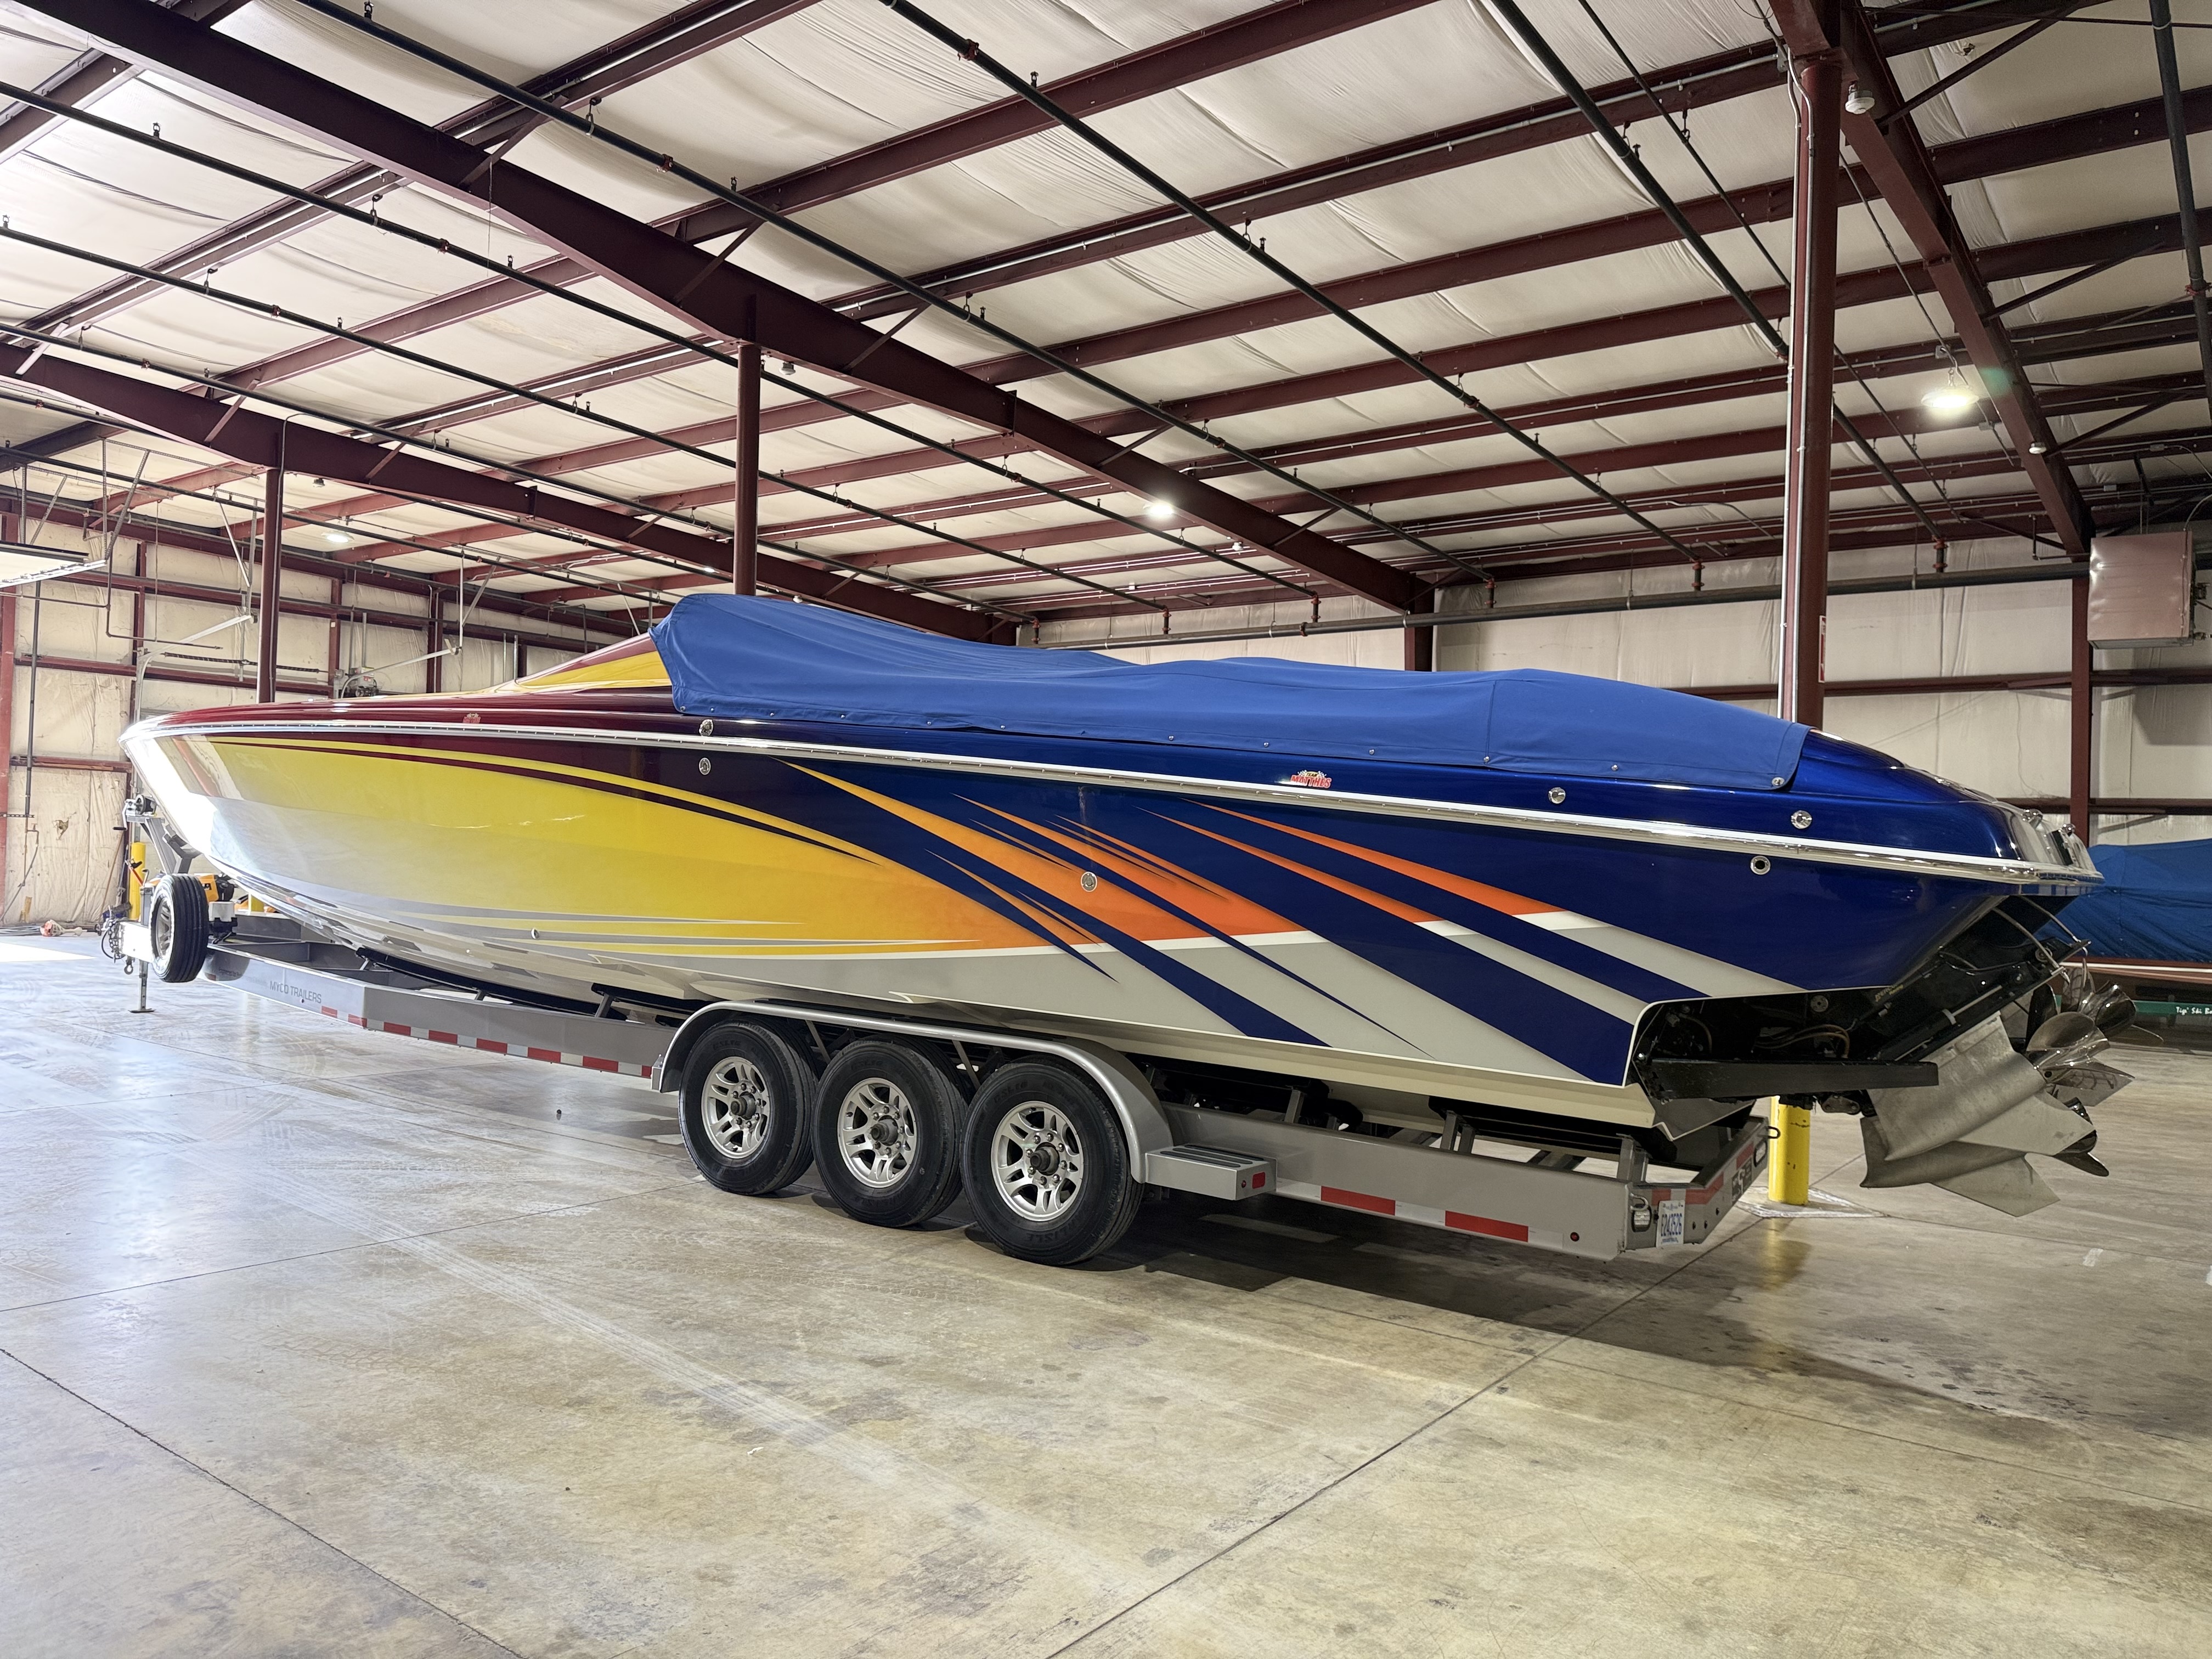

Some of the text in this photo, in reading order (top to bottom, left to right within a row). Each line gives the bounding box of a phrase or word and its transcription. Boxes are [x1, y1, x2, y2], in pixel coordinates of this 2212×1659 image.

[1291, 775, 1331, 788] MATTHES
[269, 980, 289, 994] MYCO
[290, 985, 322, 1004] TRAILERS
